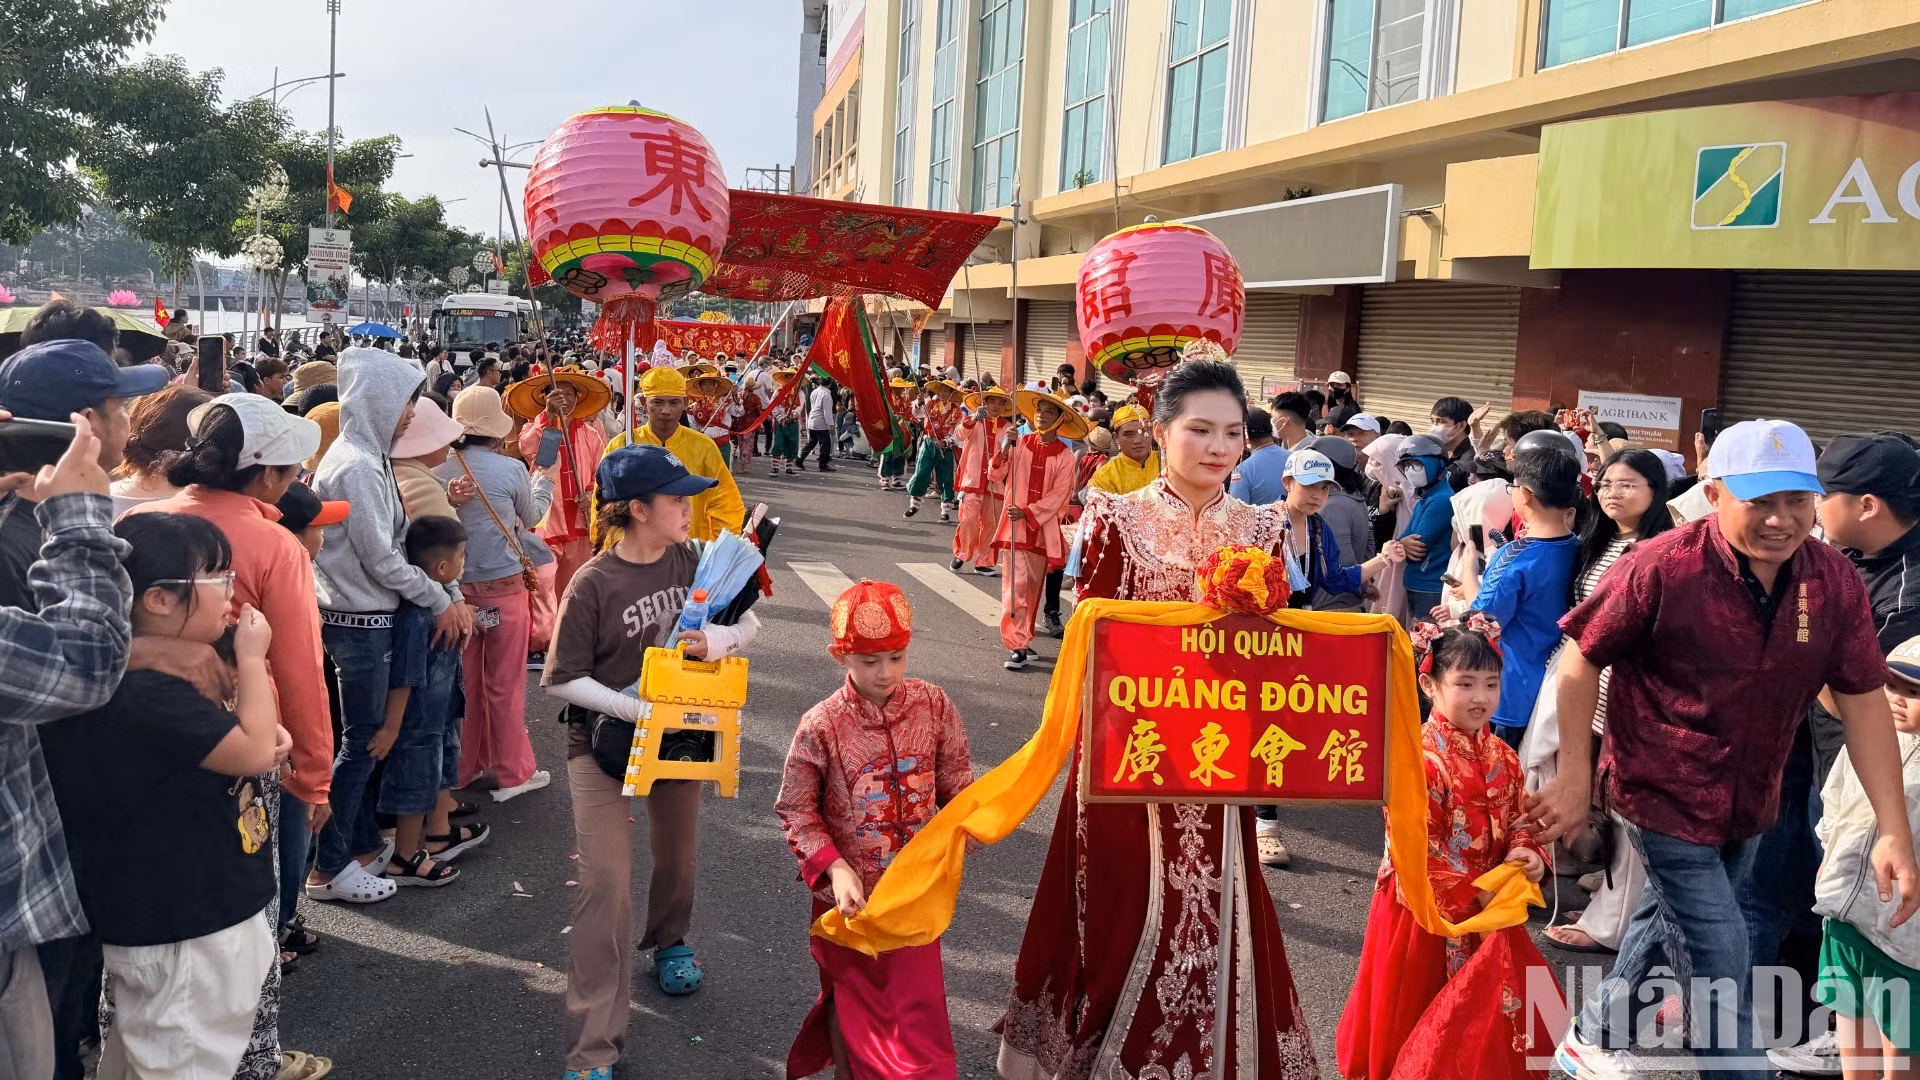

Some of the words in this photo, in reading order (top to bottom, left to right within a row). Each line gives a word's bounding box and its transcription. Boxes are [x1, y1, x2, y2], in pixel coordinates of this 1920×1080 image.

[627, 128, 713, 223] 東
[1600, 408, 1669, 421] AGRIBANK
[1181, 623, 1225, 659] HỘI
[1234, 626, 1303, 660] QUÁN
[1108, 665, 1247, 712] QUẢNG
[1260, 674, 1368, 716] ĐÔNG
[1112, 718, 1369, 788] 廣東會館
